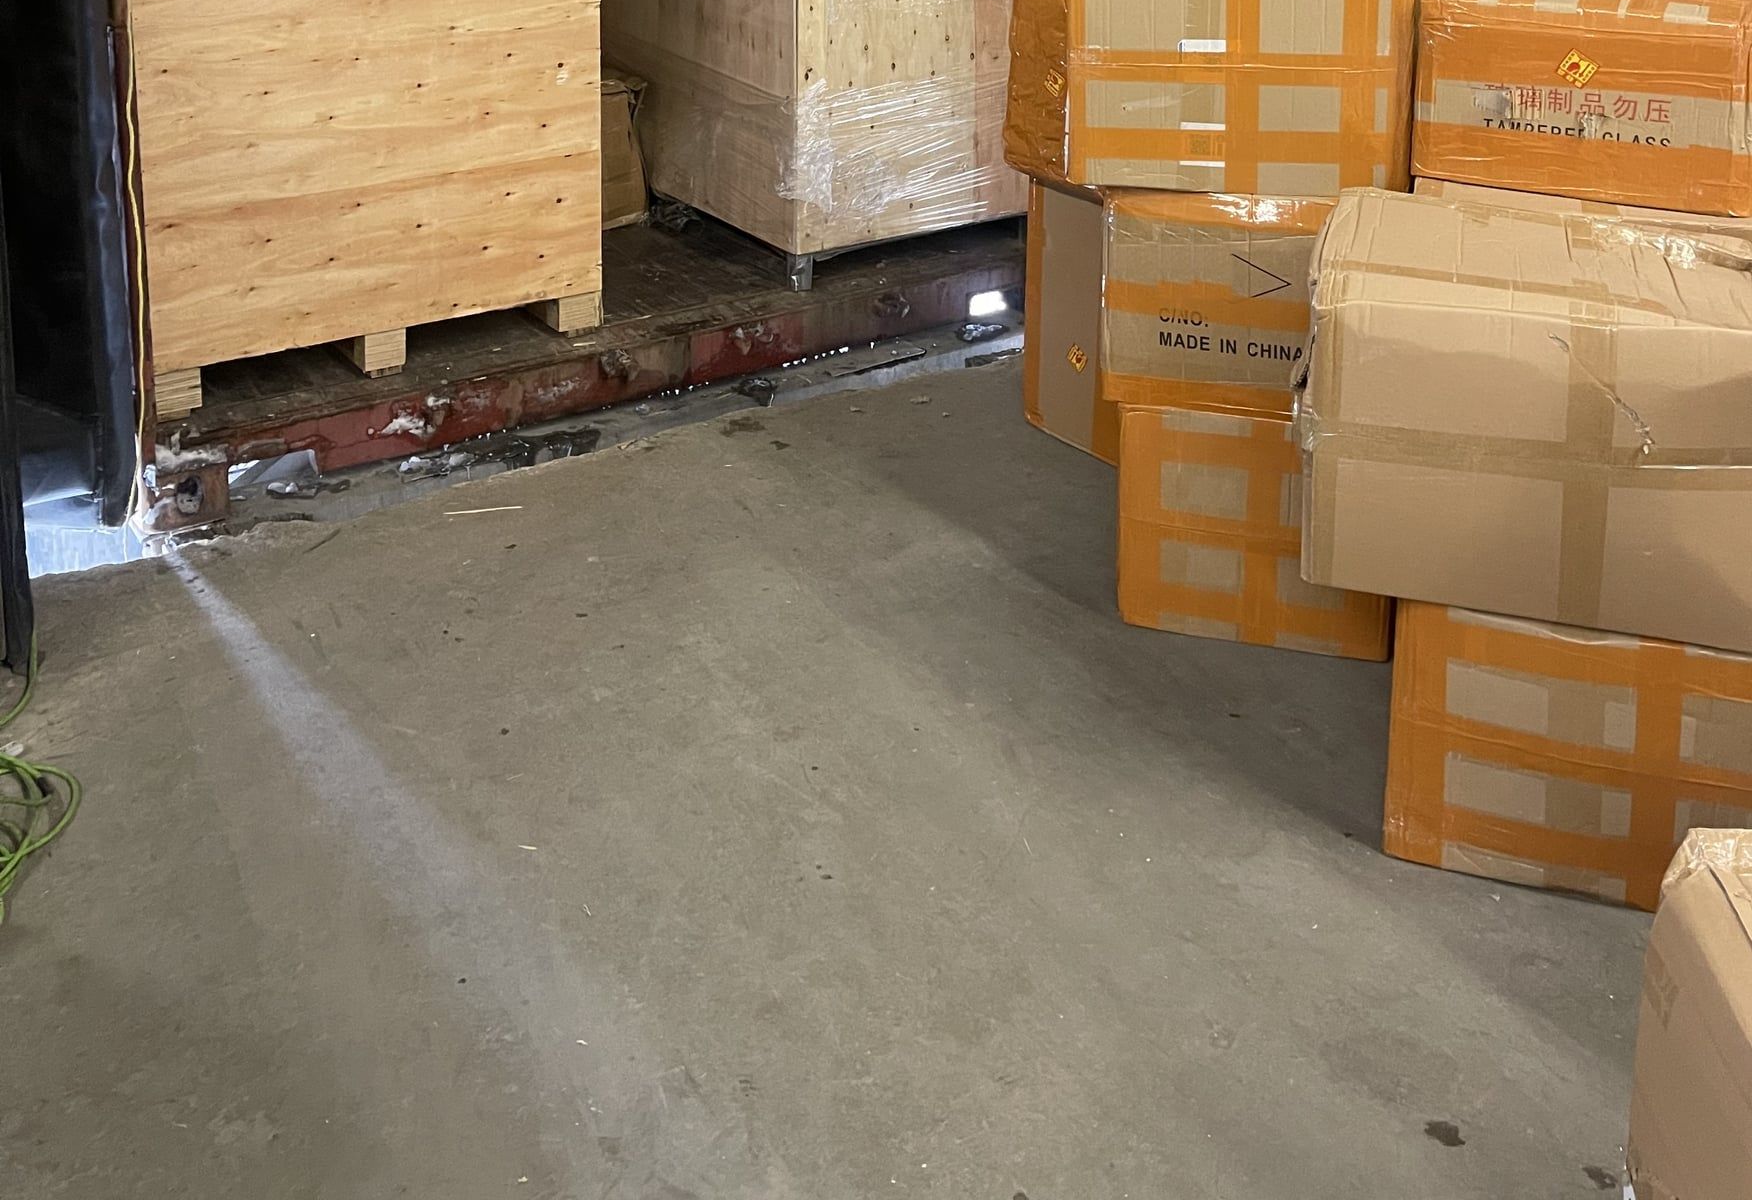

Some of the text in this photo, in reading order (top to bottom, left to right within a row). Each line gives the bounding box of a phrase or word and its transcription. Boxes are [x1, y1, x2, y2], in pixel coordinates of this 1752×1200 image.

[1484, 83, 1672, 124] 璃制品勿压
[1159, 331, 1303, 362] MADE IN CHINA
